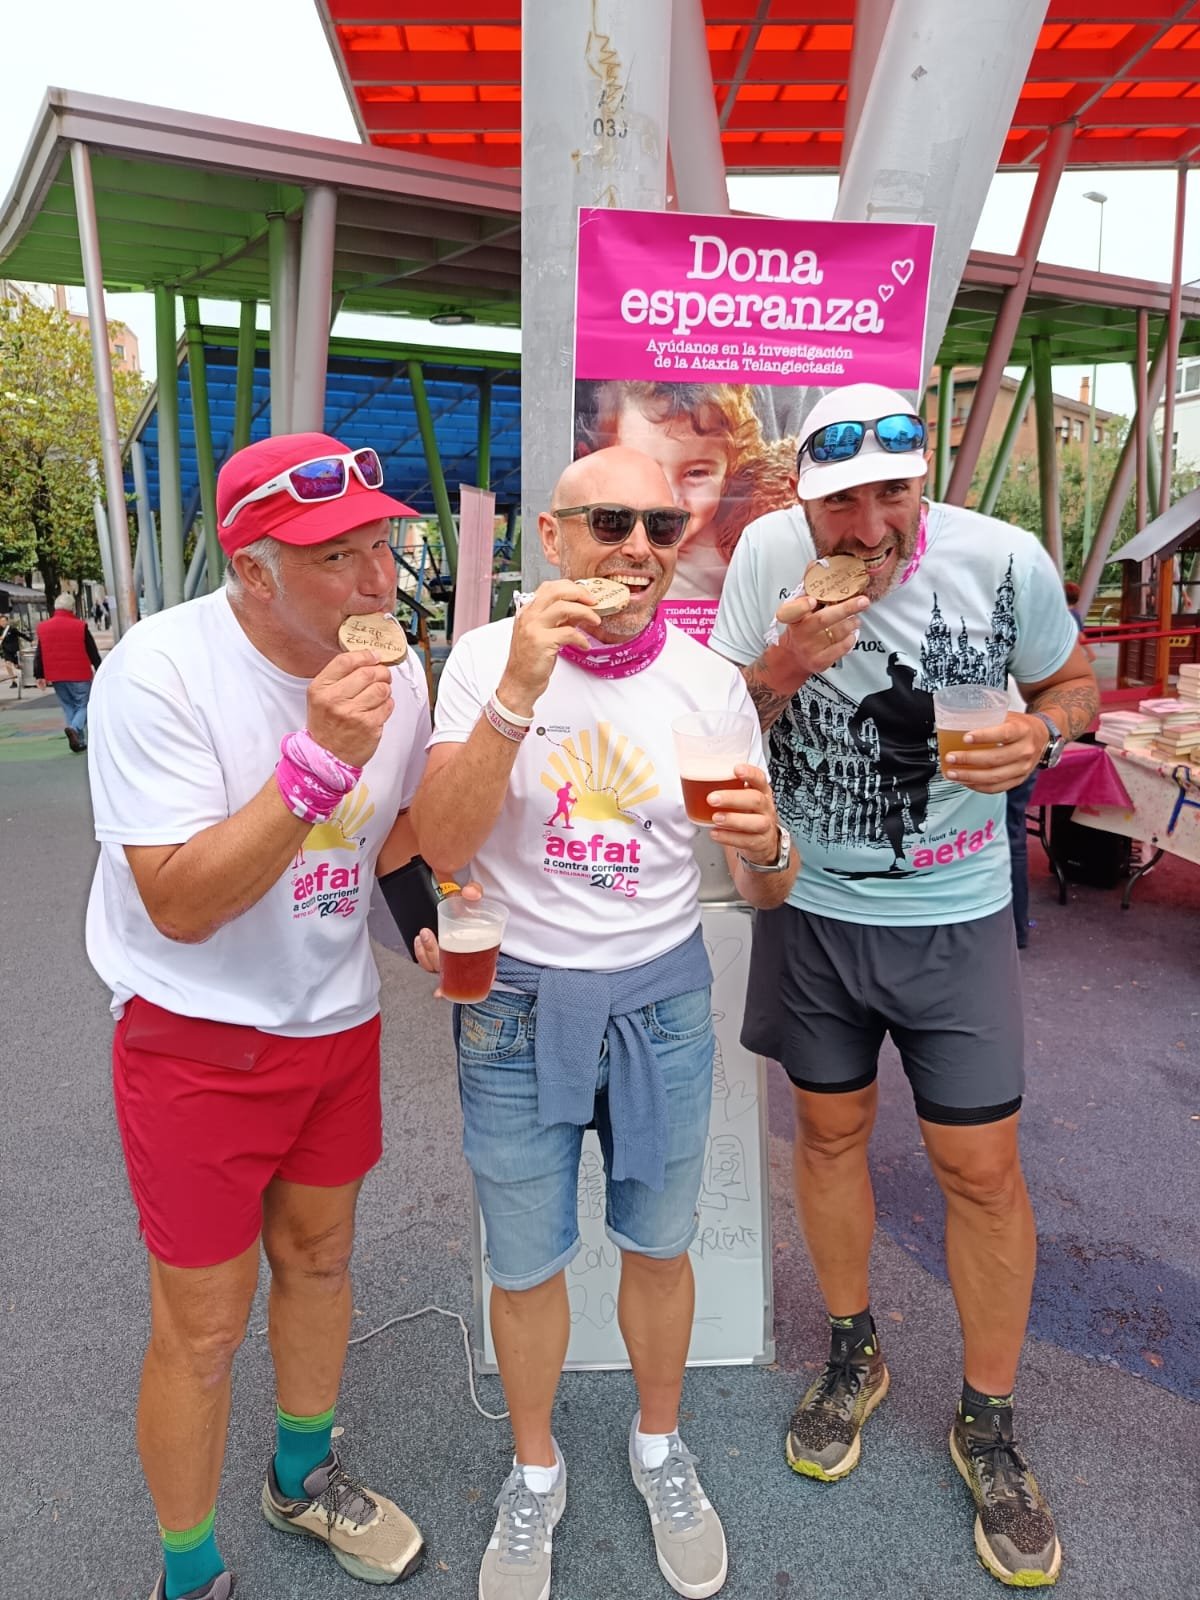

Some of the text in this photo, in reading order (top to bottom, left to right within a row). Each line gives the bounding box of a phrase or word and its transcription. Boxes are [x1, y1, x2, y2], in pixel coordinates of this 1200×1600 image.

[686, 234, 824, 286] Dona
[620, 287, 885, 336] esperanza
[646, 338, 854, 361] Ayúdanos en la investigación
[654, 355, 845, 375] de la Ataxia Telangiectasia
[545, 834, 641, 864] aefat
[912, 819, 994, 868] aefat
[543, 858, 640, 874] a contra corriente
[293, 863, 360, 901] aefat
[589, 872, 640, 898] 2025
[318, 897, 360, 919] 2025
